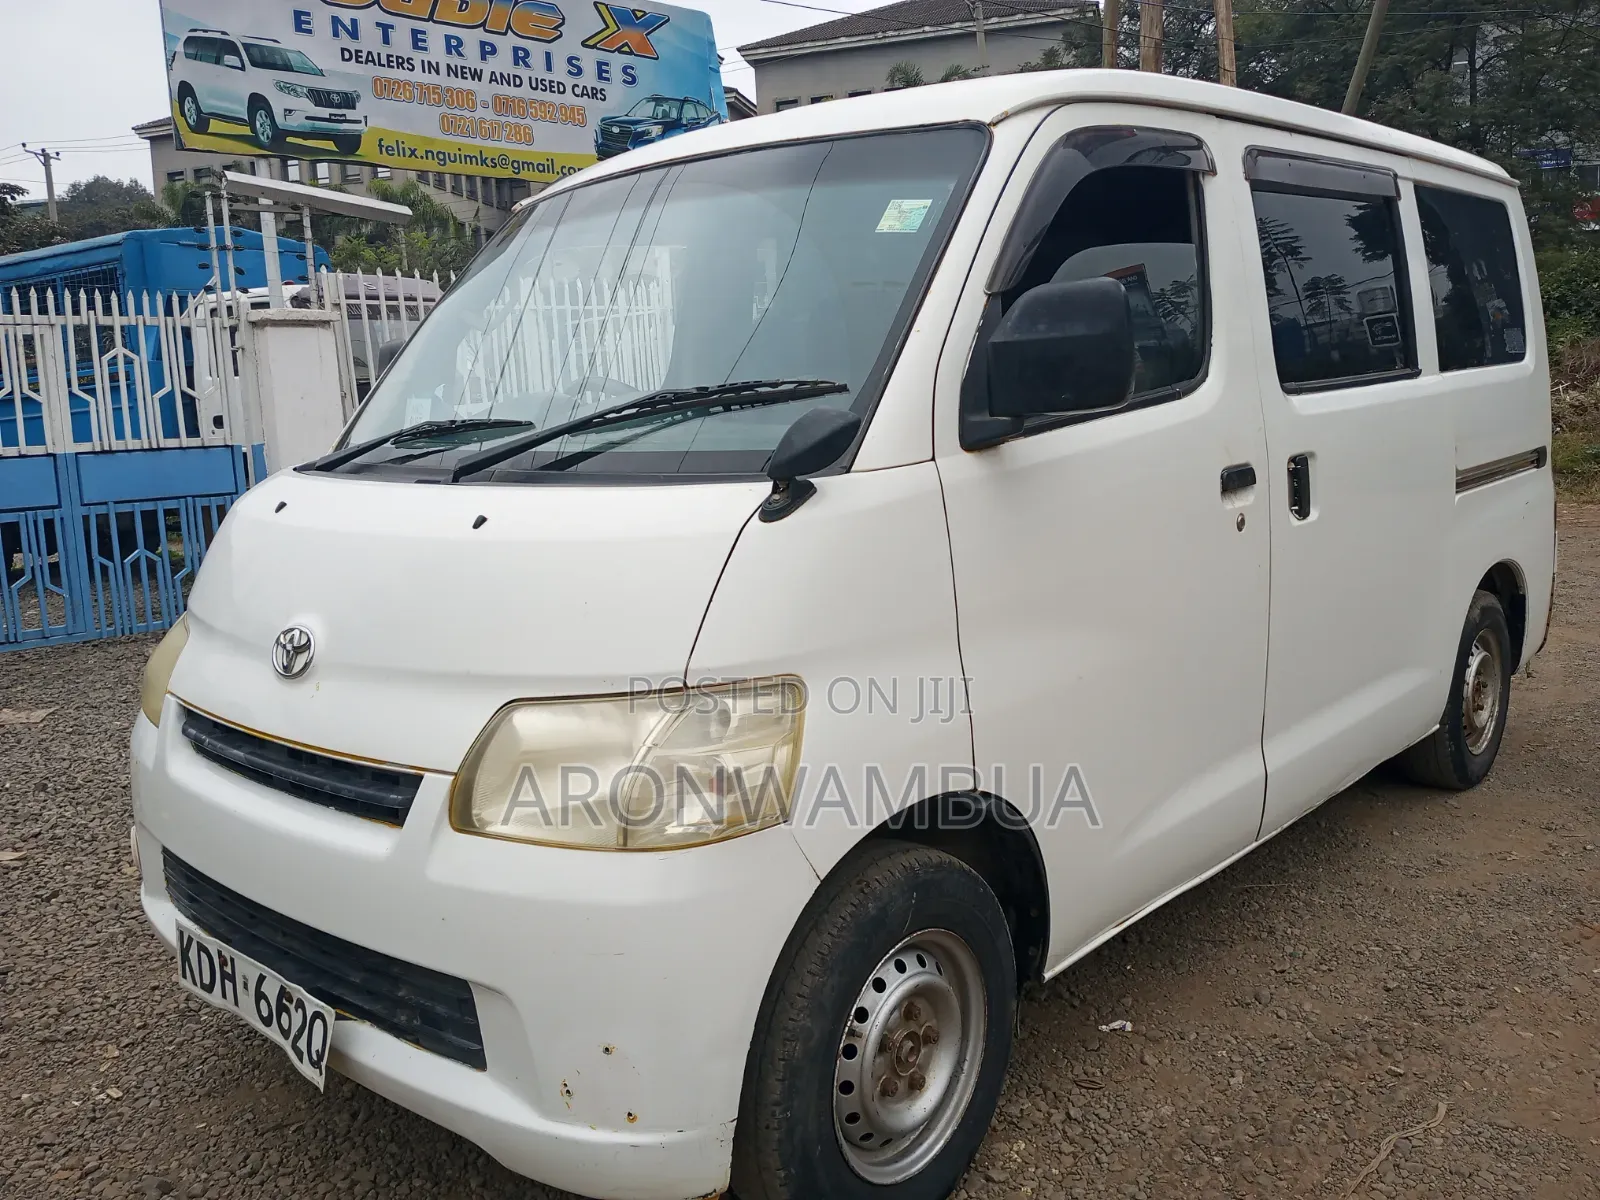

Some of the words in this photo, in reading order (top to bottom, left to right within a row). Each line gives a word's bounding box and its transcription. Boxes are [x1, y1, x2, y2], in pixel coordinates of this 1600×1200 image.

[292, 8, 639, 87] ENTERPRISES
[340, 47, 416, 72] DEALERS
[421, 59, 440, 76] IN
[446, 63, 483, 82] NEW
[489, 71, 523, 88] AND
[528, 76, 566, 95] USED
[571, 84, 607, 101] CARS
[372, 76, 414, 102] 0726
[414, 82, 443, 107] 715
[444, 86, 476, 111] 306
[492, 94, 528, 119] 0716
[527, 99, 558, 124] 592
[558, 103, 587, 127] 945
[438, 112, 477, 138] 0721
[477, 118, 502, 141] 617
[504, 121, 535, 146] 286
[377, 138, 584, 176] felix.nguimks@gmail.co
[178, 928, 240, 1009] KDH
[254, 972, 329, 1077] 662Q
